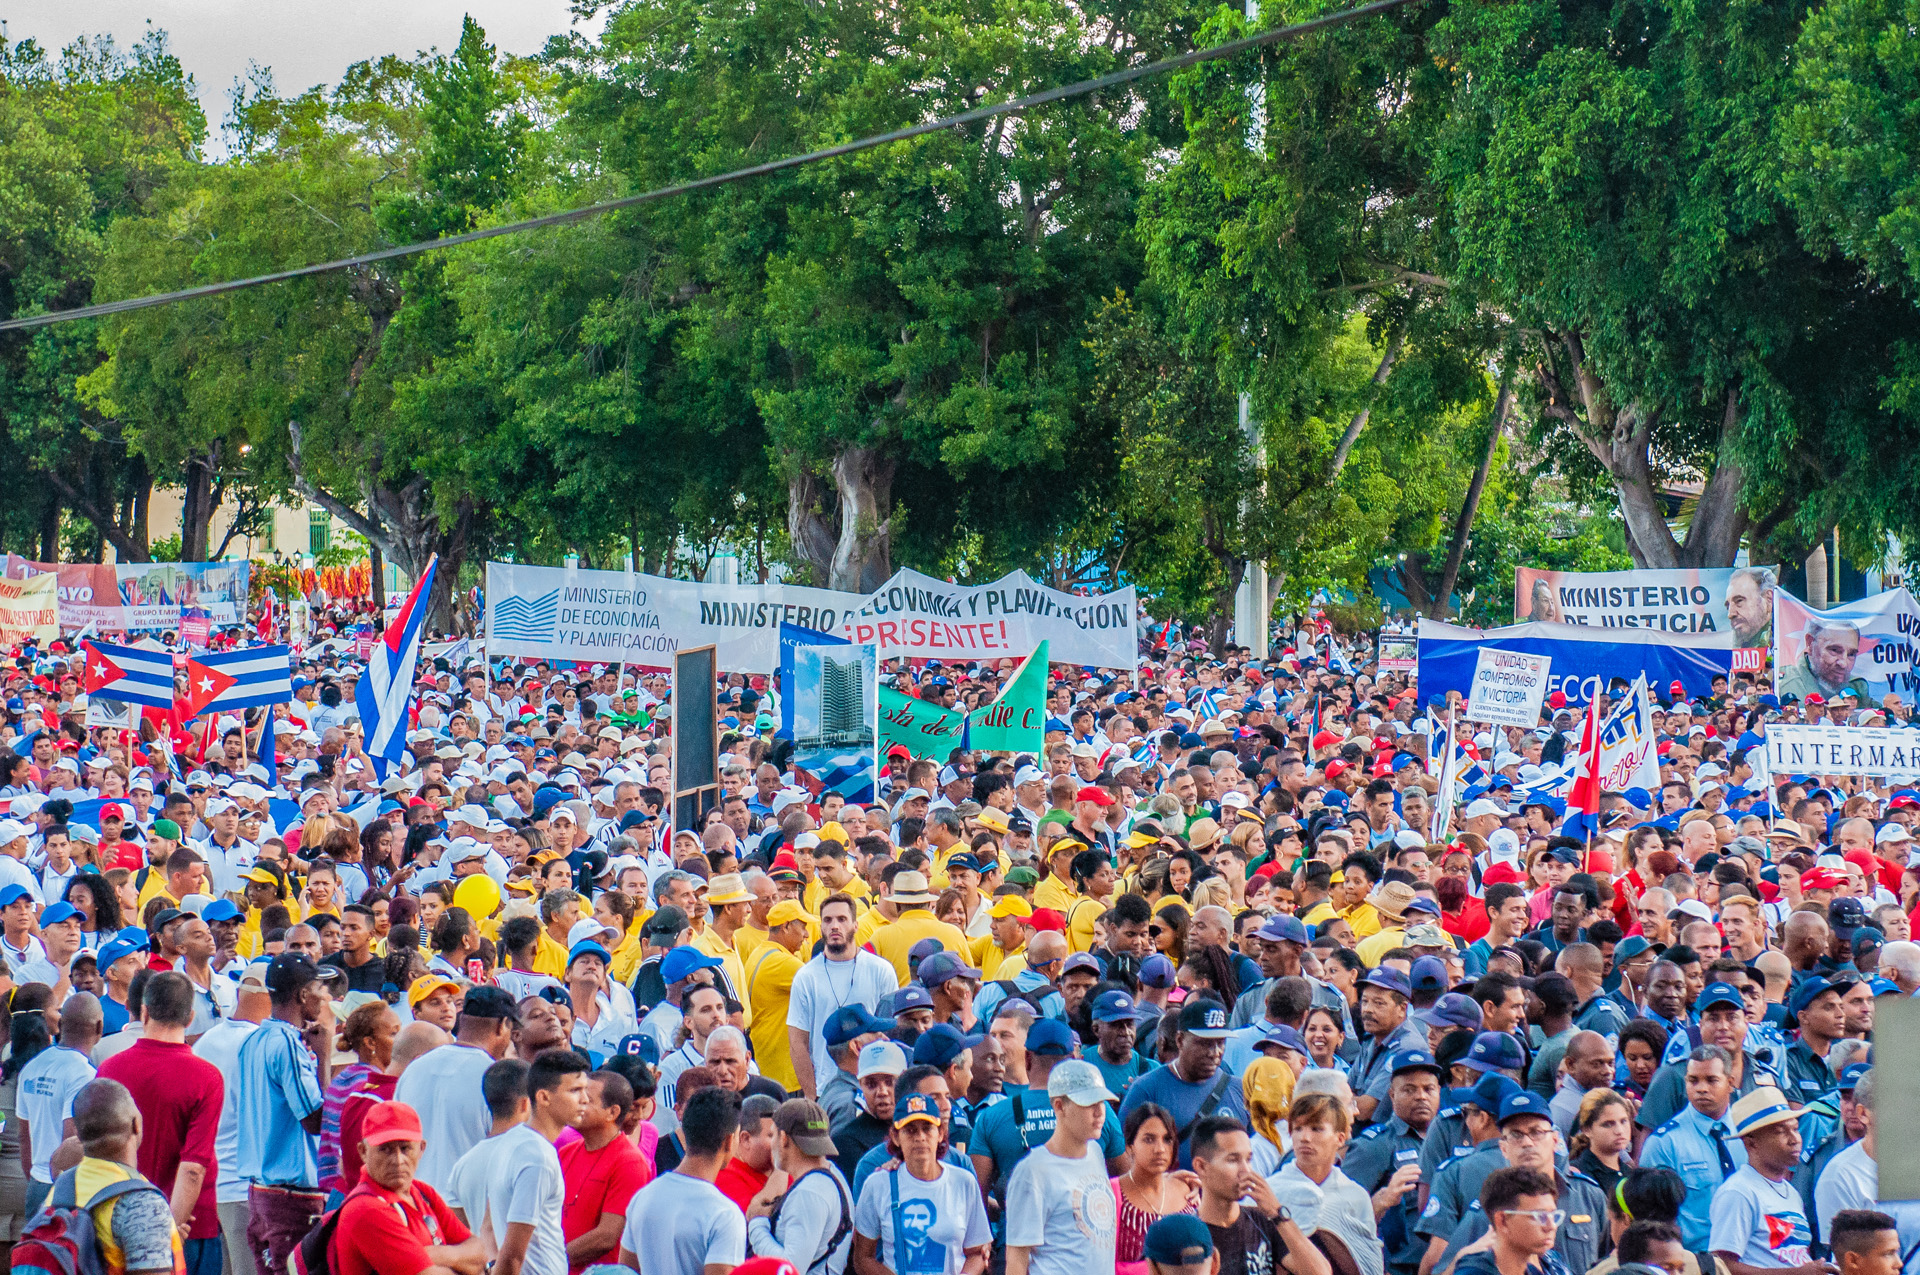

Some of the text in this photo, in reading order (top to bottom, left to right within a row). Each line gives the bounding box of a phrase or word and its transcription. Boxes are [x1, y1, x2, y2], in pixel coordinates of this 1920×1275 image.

[564, 586, 647, 607] MINISTERIO
[968, 592, 981, 617] Y
[1559, 586, 1710, 608] MINISTERIO
[561, 608, 660, 630] DE ECONOMÍA
[559, 629, 679, 653] Y PLANIFICACIÓN
[845, 619, 1009, 649] ¡PRESENTE!
[1494, 654, 1528, 671] UNIDAD
[1479, 670, 1537, 688] COMPROMISO
[1483, 686, 1527, 703] Y VICTORIA
[921, 714, 949, 736] de
[1776, 742, 1920, 768] INTERMAR
[627, 1040, 641, 1056] C
